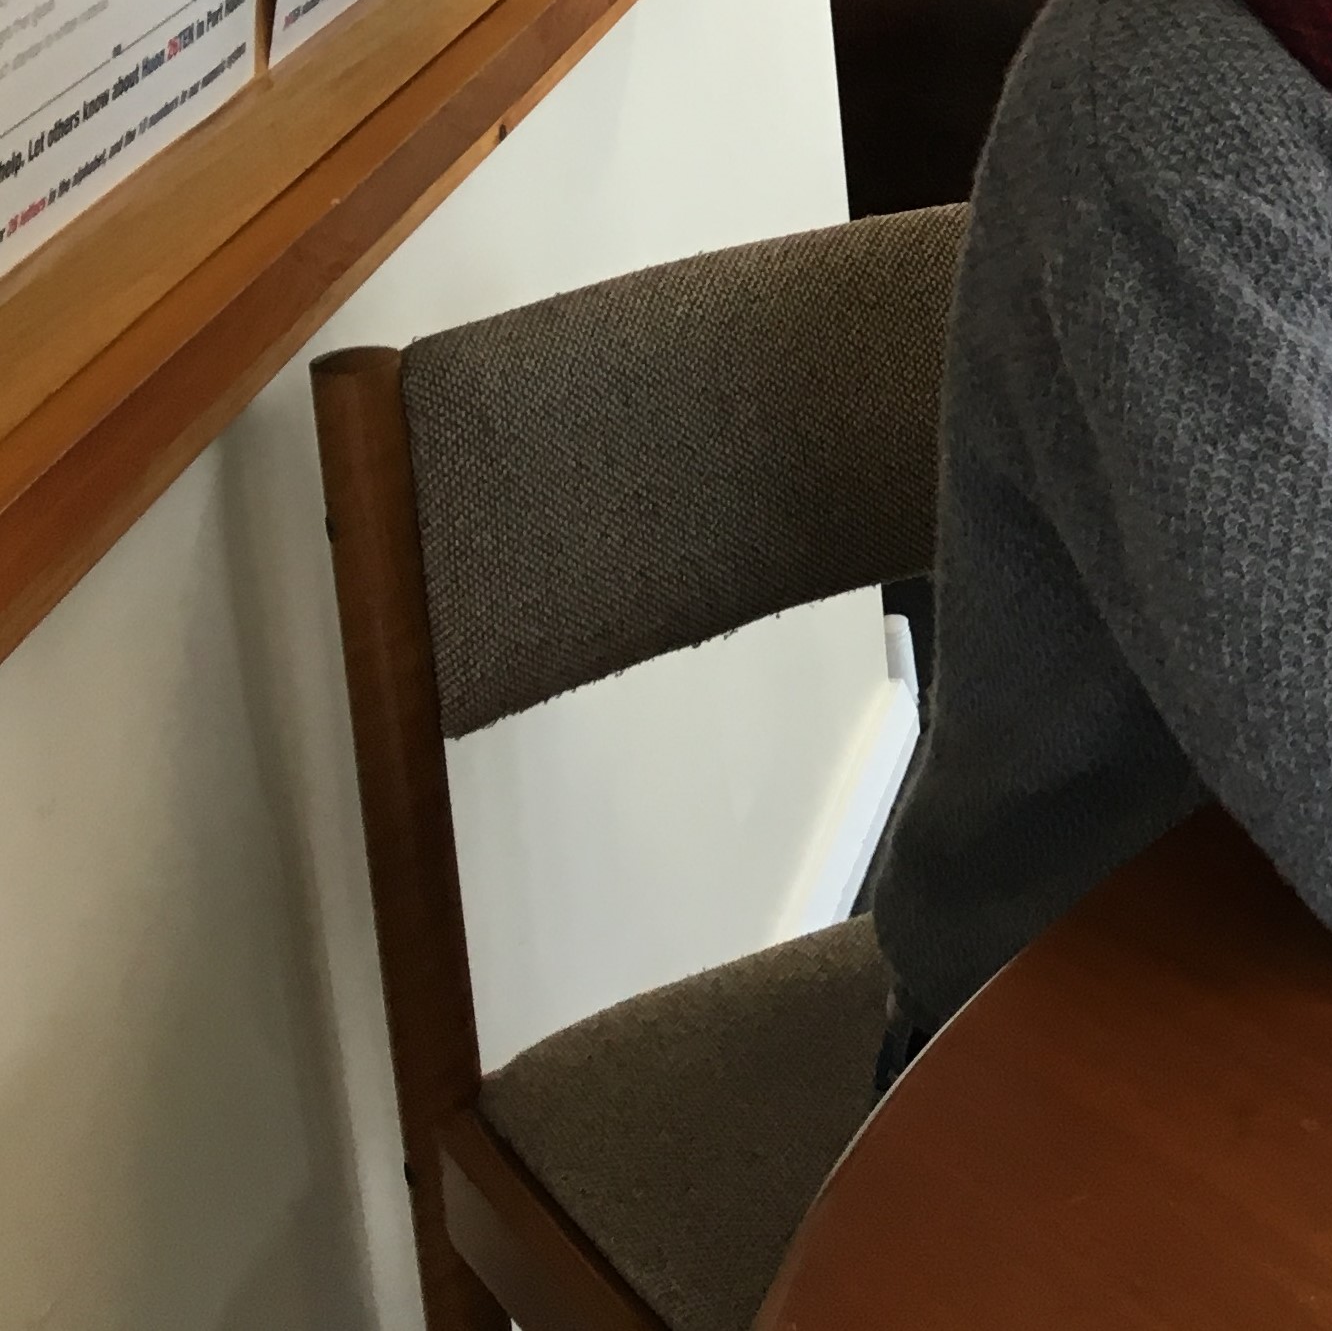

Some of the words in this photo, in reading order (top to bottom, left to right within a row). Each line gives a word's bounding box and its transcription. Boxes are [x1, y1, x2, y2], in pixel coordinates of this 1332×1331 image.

[28, 131, 45, 162] Let
[47, 109, 80, 148] others
[83, 88, 110, 122] know
[112, 62, 140, 101] about
